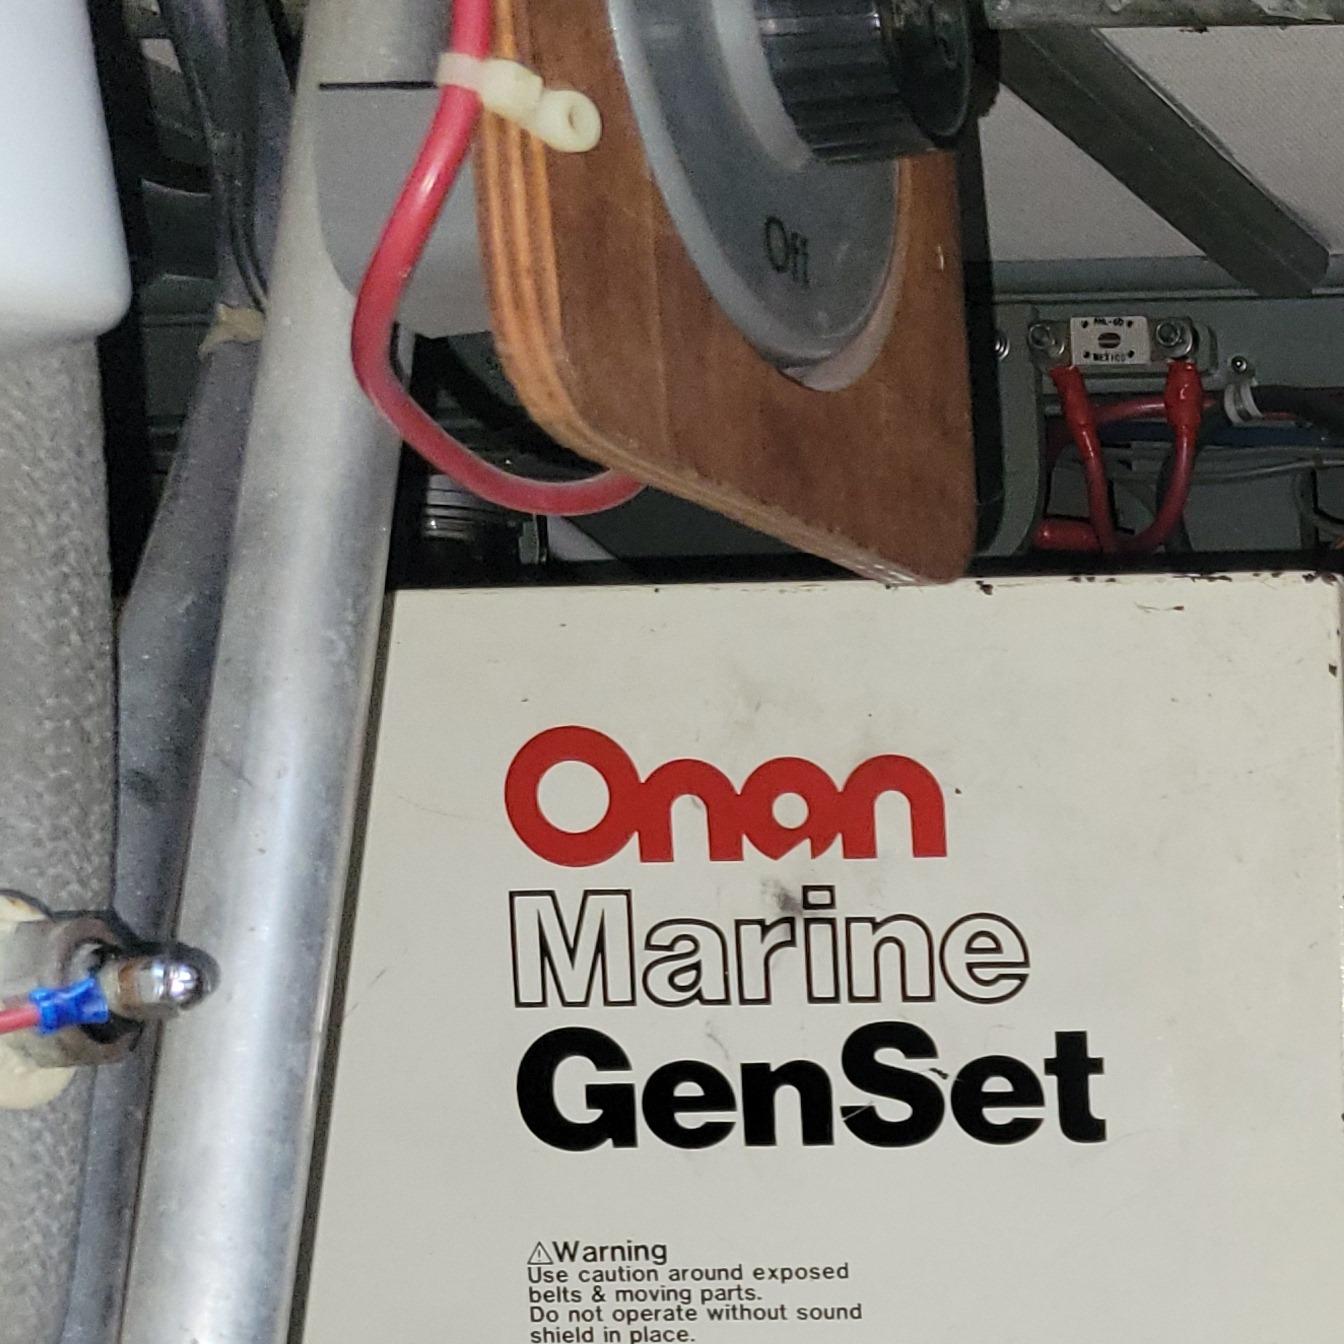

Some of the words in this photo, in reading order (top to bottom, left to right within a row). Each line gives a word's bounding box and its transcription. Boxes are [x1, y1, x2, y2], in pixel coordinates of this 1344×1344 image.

[504, 725, 947, 867] Onan
[508, 885, 1030, 1008] Marine
[516, 1021, 1107, 1152] GenSet
[552, 1240, 667, 1266] Warning
[528, 1267, 569, 1284] Use
[579, 1266, 659, 1283] caution
[669, 1264, 743, 1282] around
[753, 1263, 849, 1284] exposed
[529, 1286, 582, 1304] belts
[592, 1285, 606, 1302] &
[616, 1285, 692, 1305] moving
[701, 1285, 762, 1305] parts.
[530, 1306, 559, 1323] Do
[569, 1306, 604, 1323] not
[612, 1305, 698, 1326] operate
[707, 1304, 787, 1321] without
[797, 1304, 862, 1321] sound
[531, 1327, 594, 1344] shield
[604, 1327, 621, 1343] in
